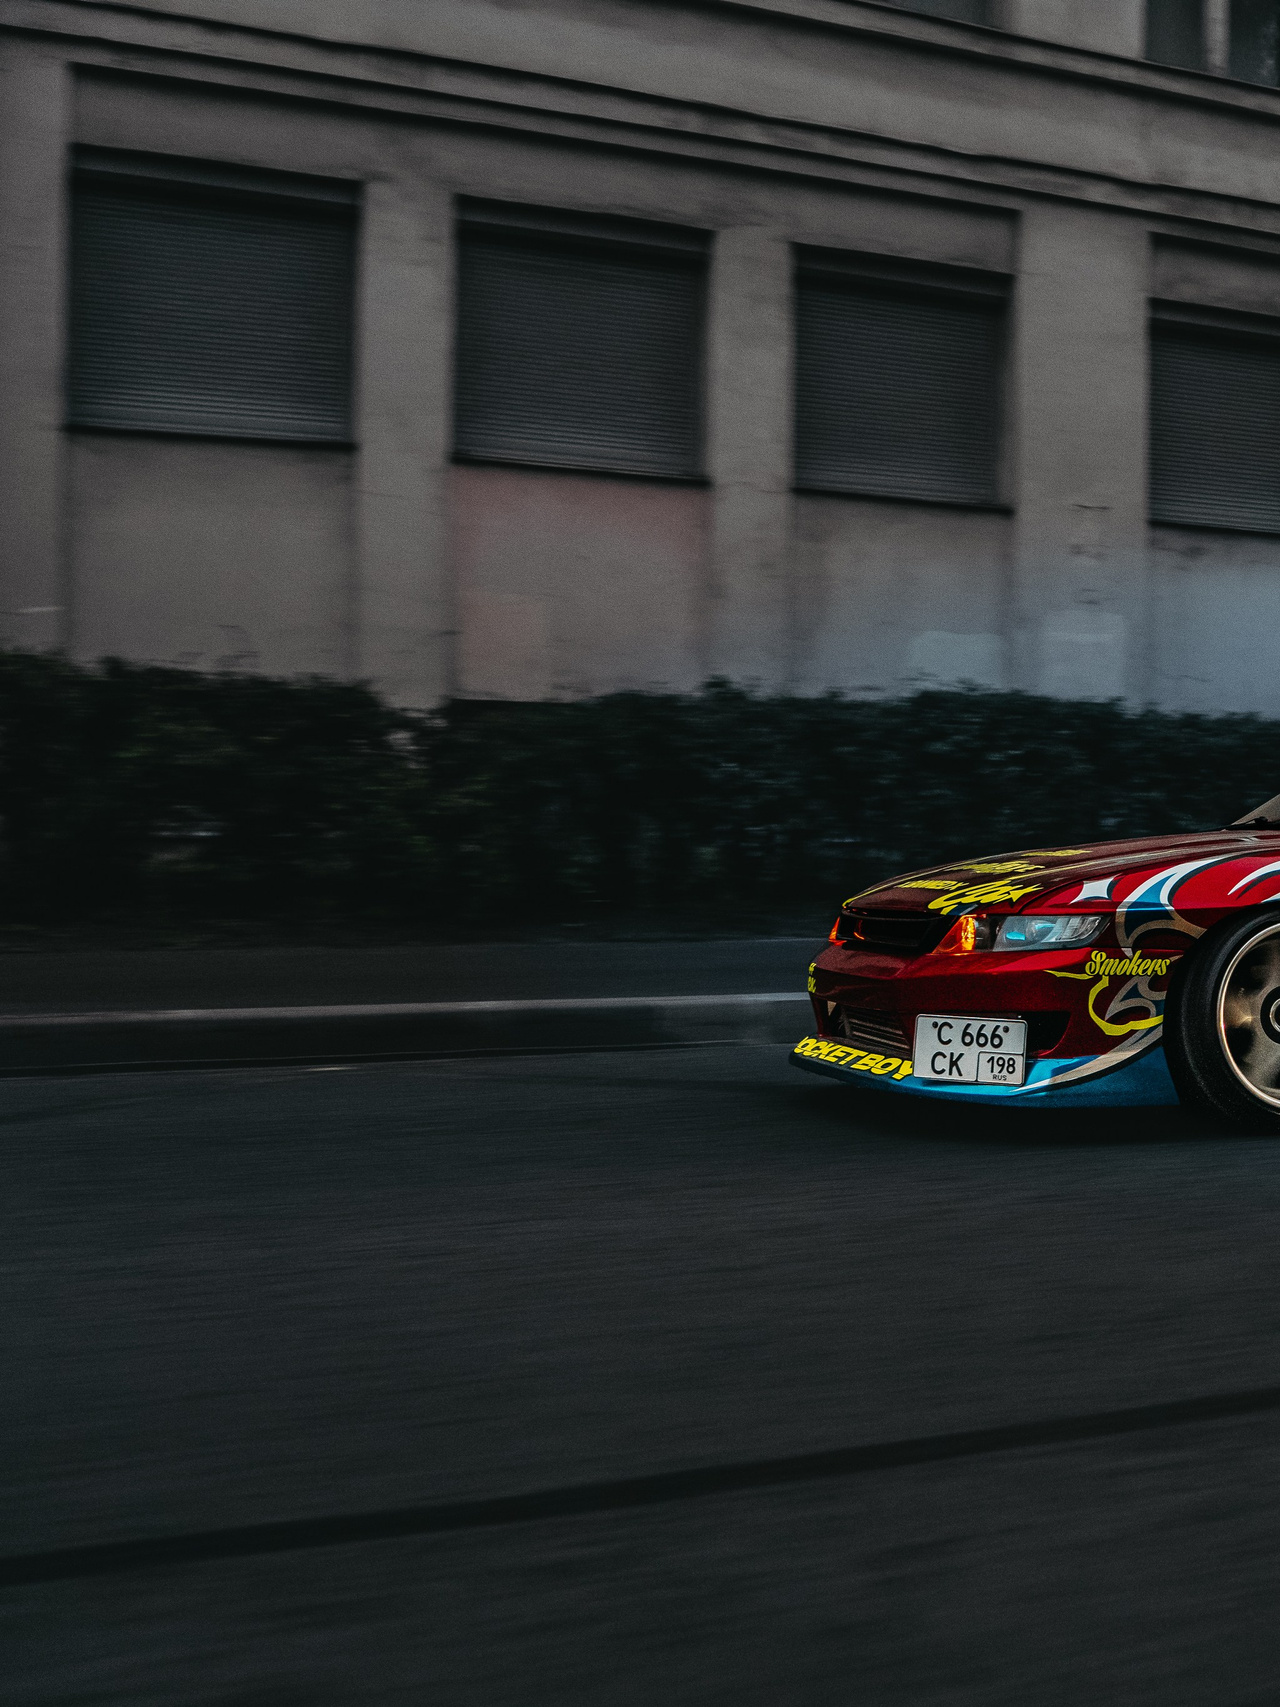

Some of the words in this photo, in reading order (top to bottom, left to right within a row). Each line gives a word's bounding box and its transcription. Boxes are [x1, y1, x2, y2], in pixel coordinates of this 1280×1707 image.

[1085, 950, 1171, 976] Smokers
[937, 1021, 954, 1046] C
[961, 1022, 1004, 1049] 666
[793, 1036, 868, 1066] OCKET
[931, 1051, 964, 1077] CK
[986, 1055, 1016, 1075] 198
